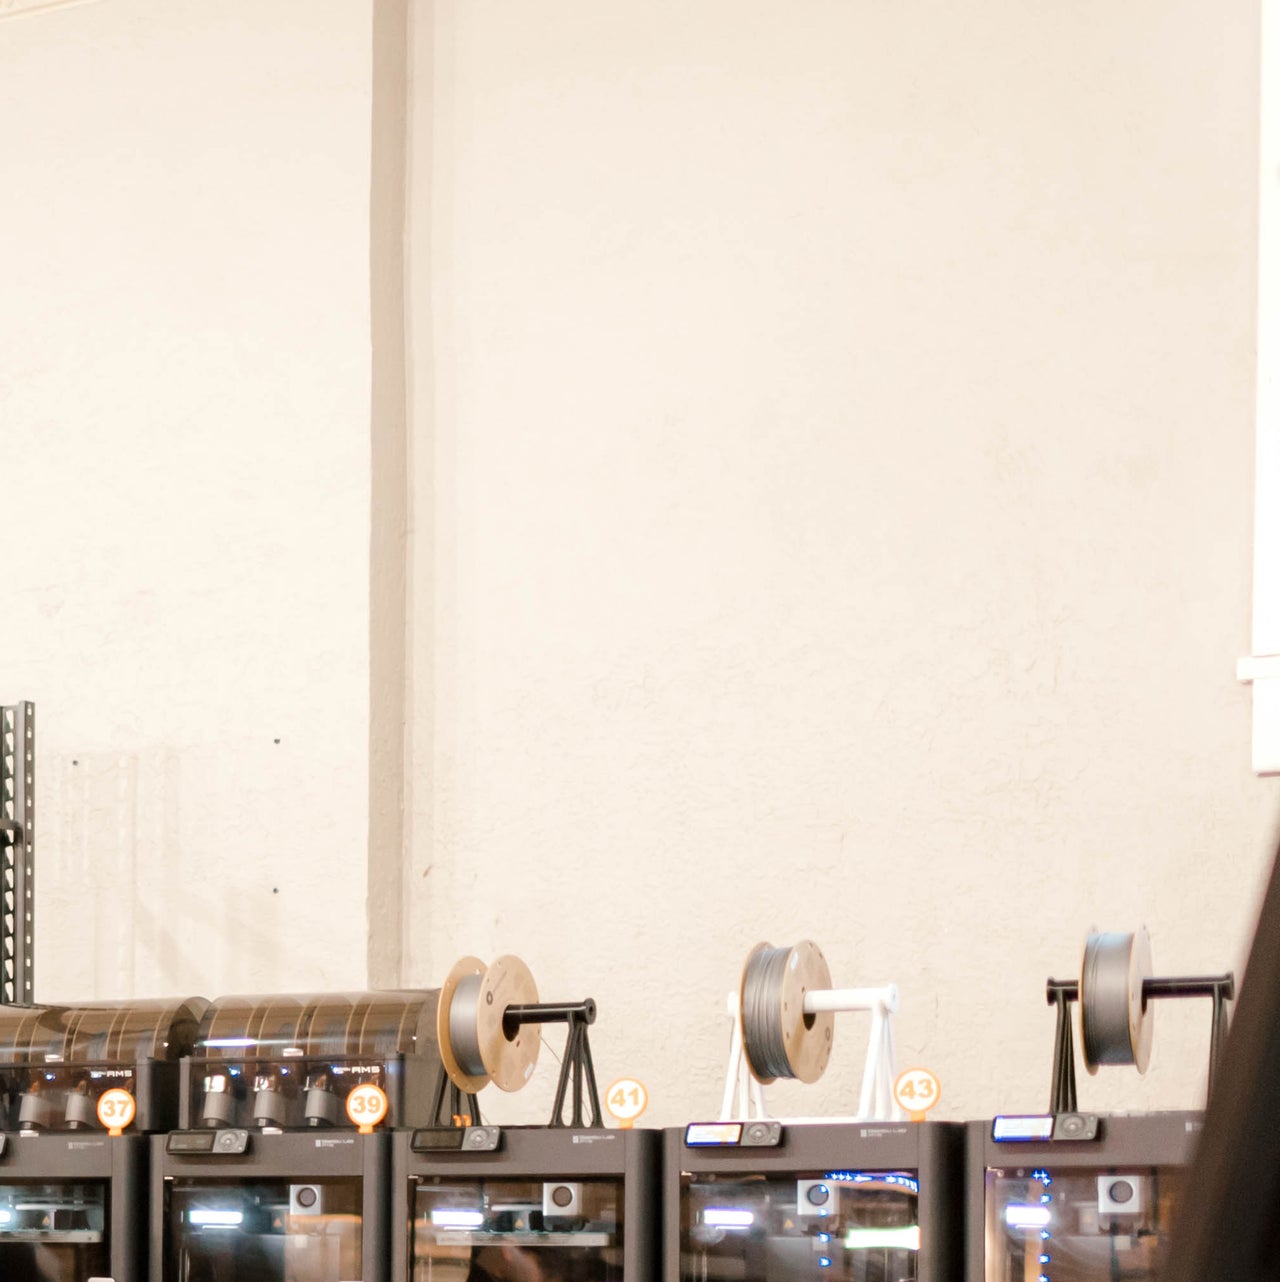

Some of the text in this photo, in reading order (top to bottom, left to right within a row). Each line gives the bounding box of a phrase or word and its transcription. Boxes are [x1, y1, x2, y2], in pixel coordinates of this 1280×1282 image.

[610, 1087, 640, 1107] 41
[899, 1078, 934, 1099] 43
[103, 1100, 130, 1117] 37
[353, 1095, 381, 1114] 39
